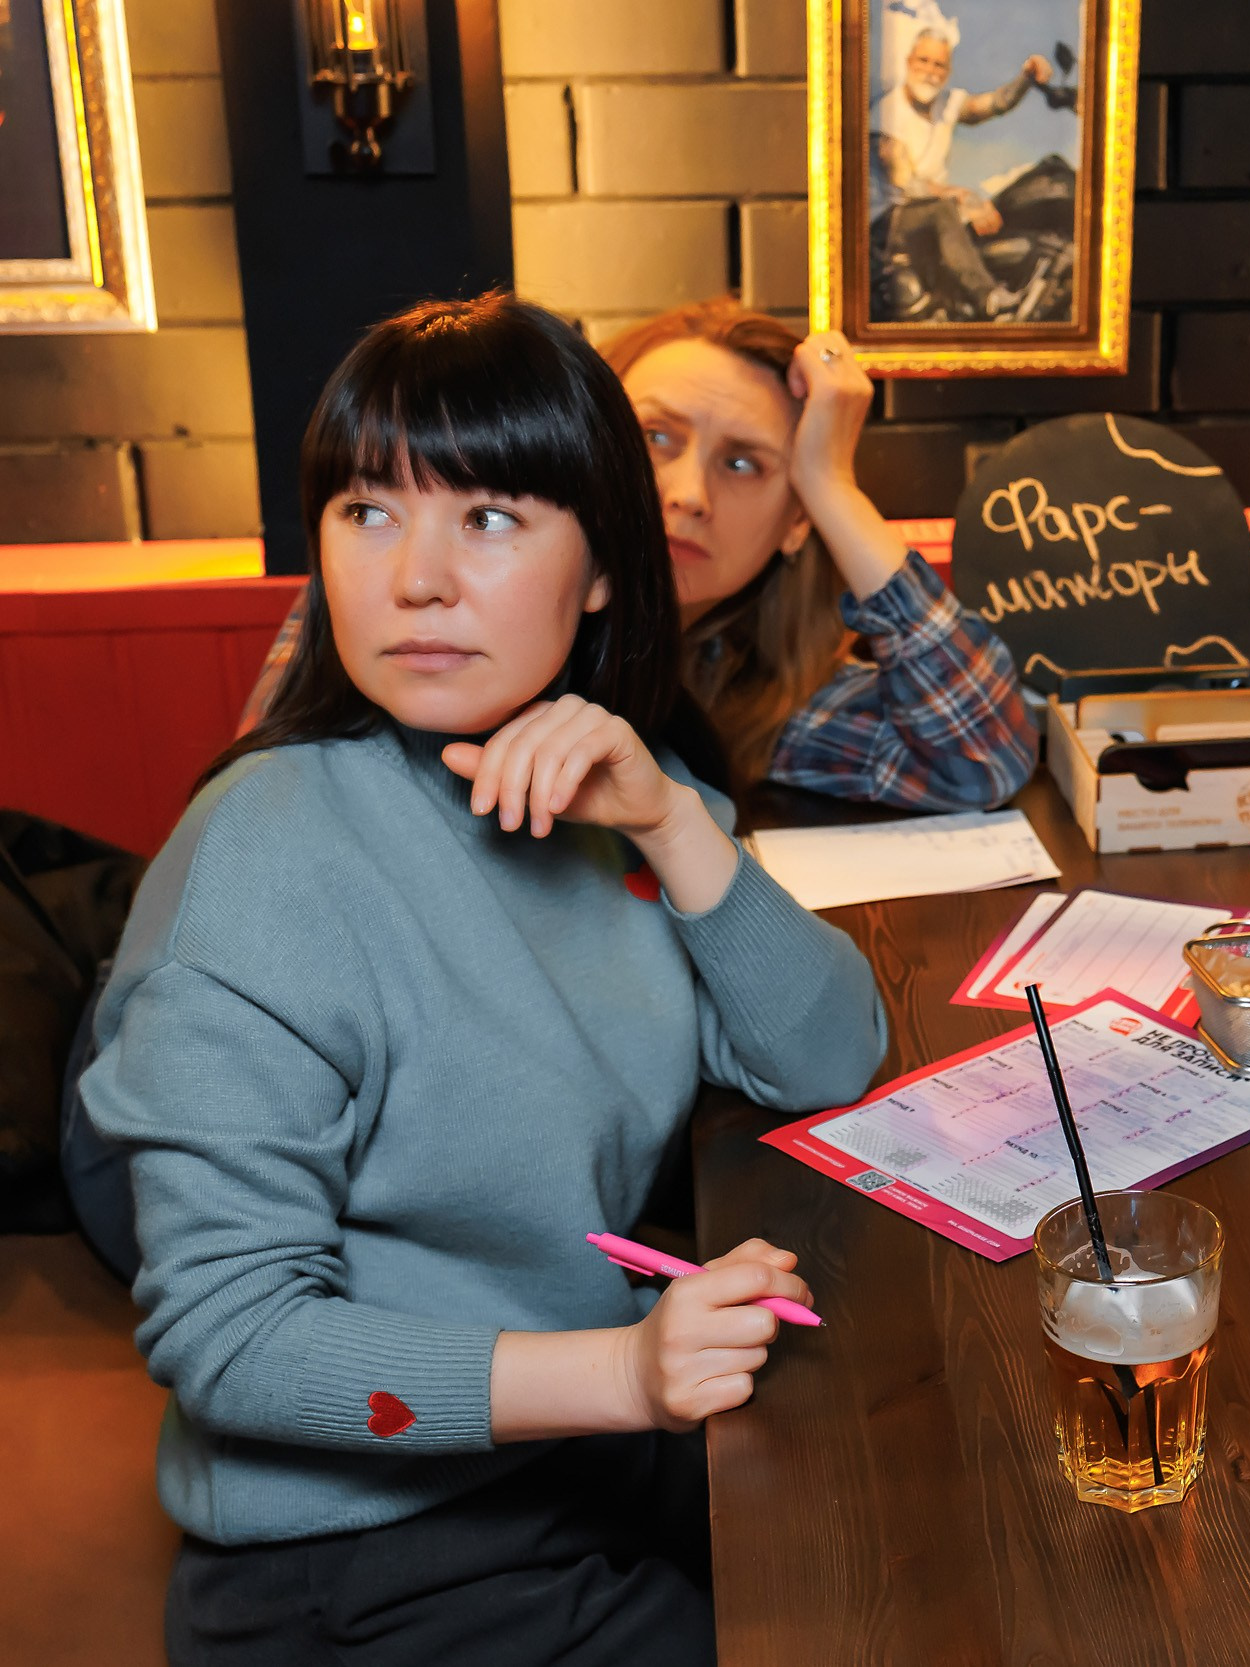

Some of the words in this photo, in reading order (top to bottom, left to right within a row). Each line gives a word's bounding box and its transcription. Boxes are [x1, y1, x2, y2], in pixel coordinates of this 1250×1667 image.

[982, 477, 1173, 561] Фарс-
[1147, 1029, 1172, 1042] НЕ
[1131, 1036, 1171, 1053] ДЛЯ
